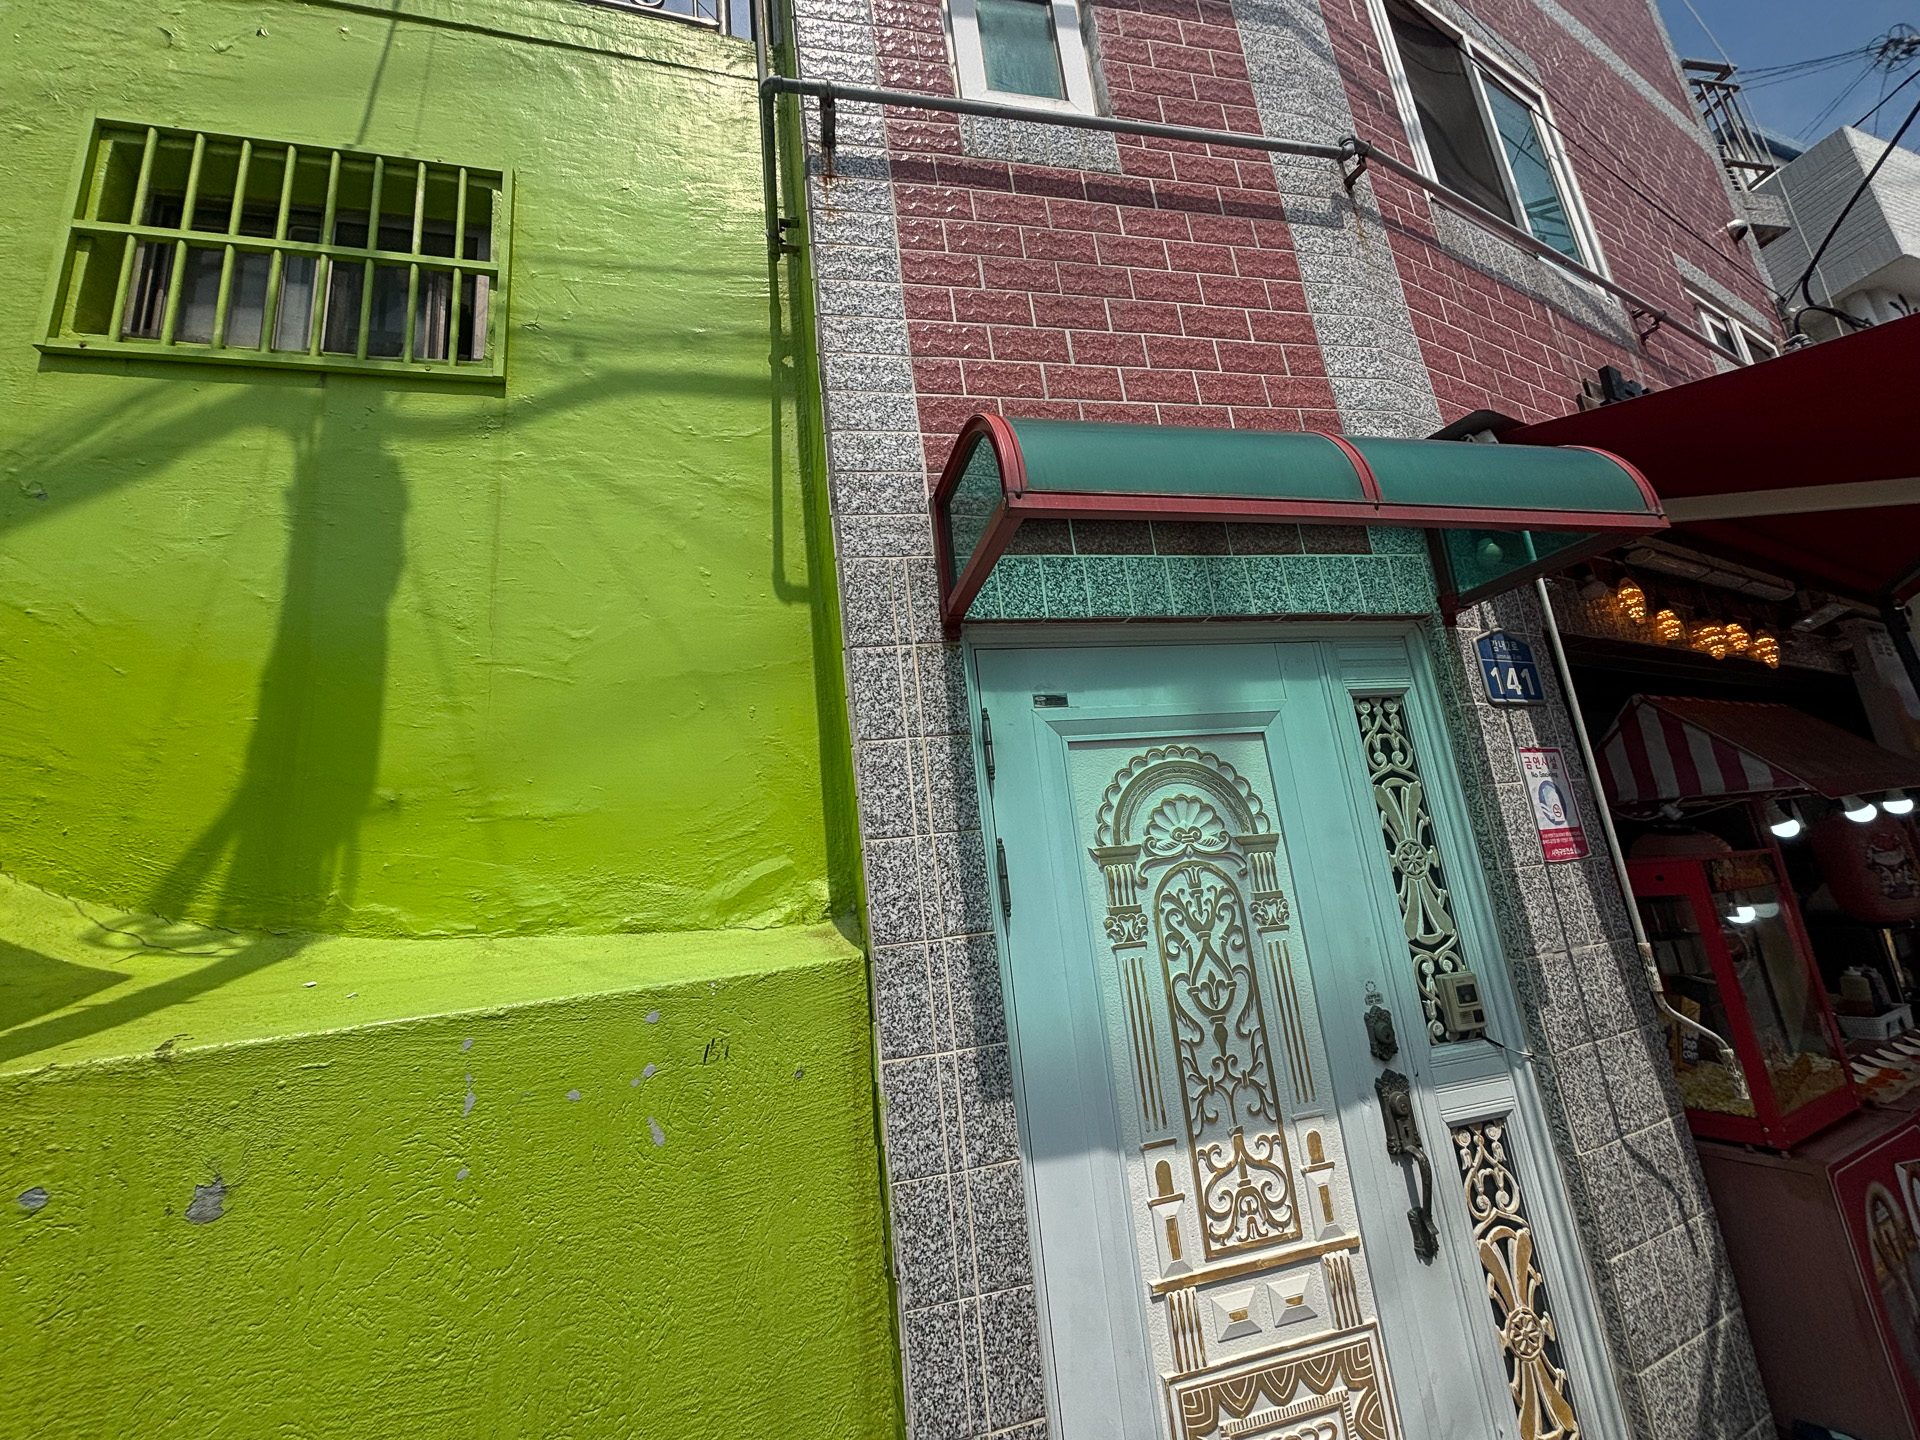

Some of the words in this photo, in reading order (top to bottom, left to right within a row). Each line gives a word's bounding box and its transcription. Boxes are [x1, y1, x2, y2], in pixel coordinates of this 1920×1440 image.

[1491, 640, 1519, 652] 감내2로
[1490, 666, 1535, 696] 141
[1523, 756, 1559, 770] 금연시설
[1539, 771, 1559, 779] Smoking
